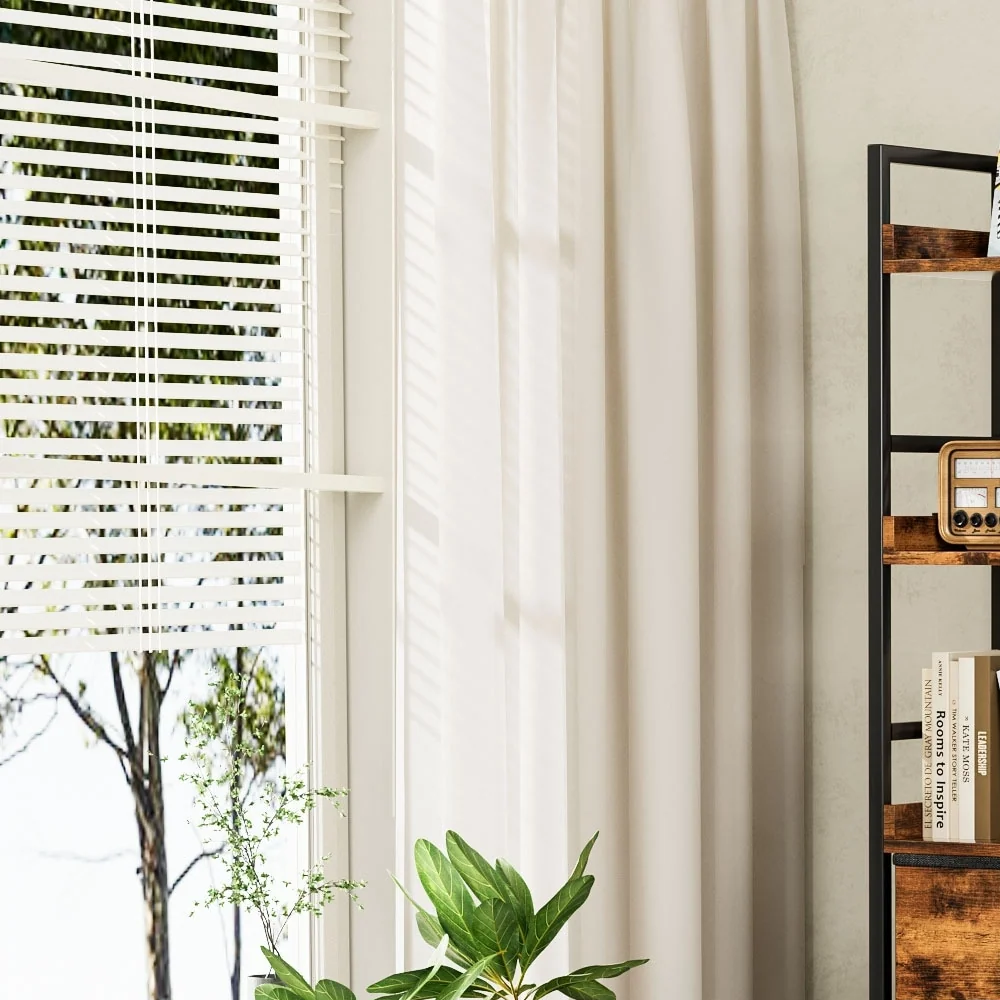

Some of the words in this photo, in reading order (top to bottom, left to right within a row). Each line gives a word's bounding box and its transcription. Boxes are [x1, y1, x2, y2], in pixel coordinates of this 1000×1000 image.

[924, 679, 932, 732] MOUNTAIN
[924, 734, 932, 759] GRAY
[936, 711, 946, 757] Rooms
[962, 725, 970, 752] KATE
[977, 731, 987, 776] LEADERSHIP
[924, 762, 932, 775] DE
[936, 762, 946, 776] to
[962, 754, 970, 783] MOSS
[933, 781, 947, 829] Inspire
